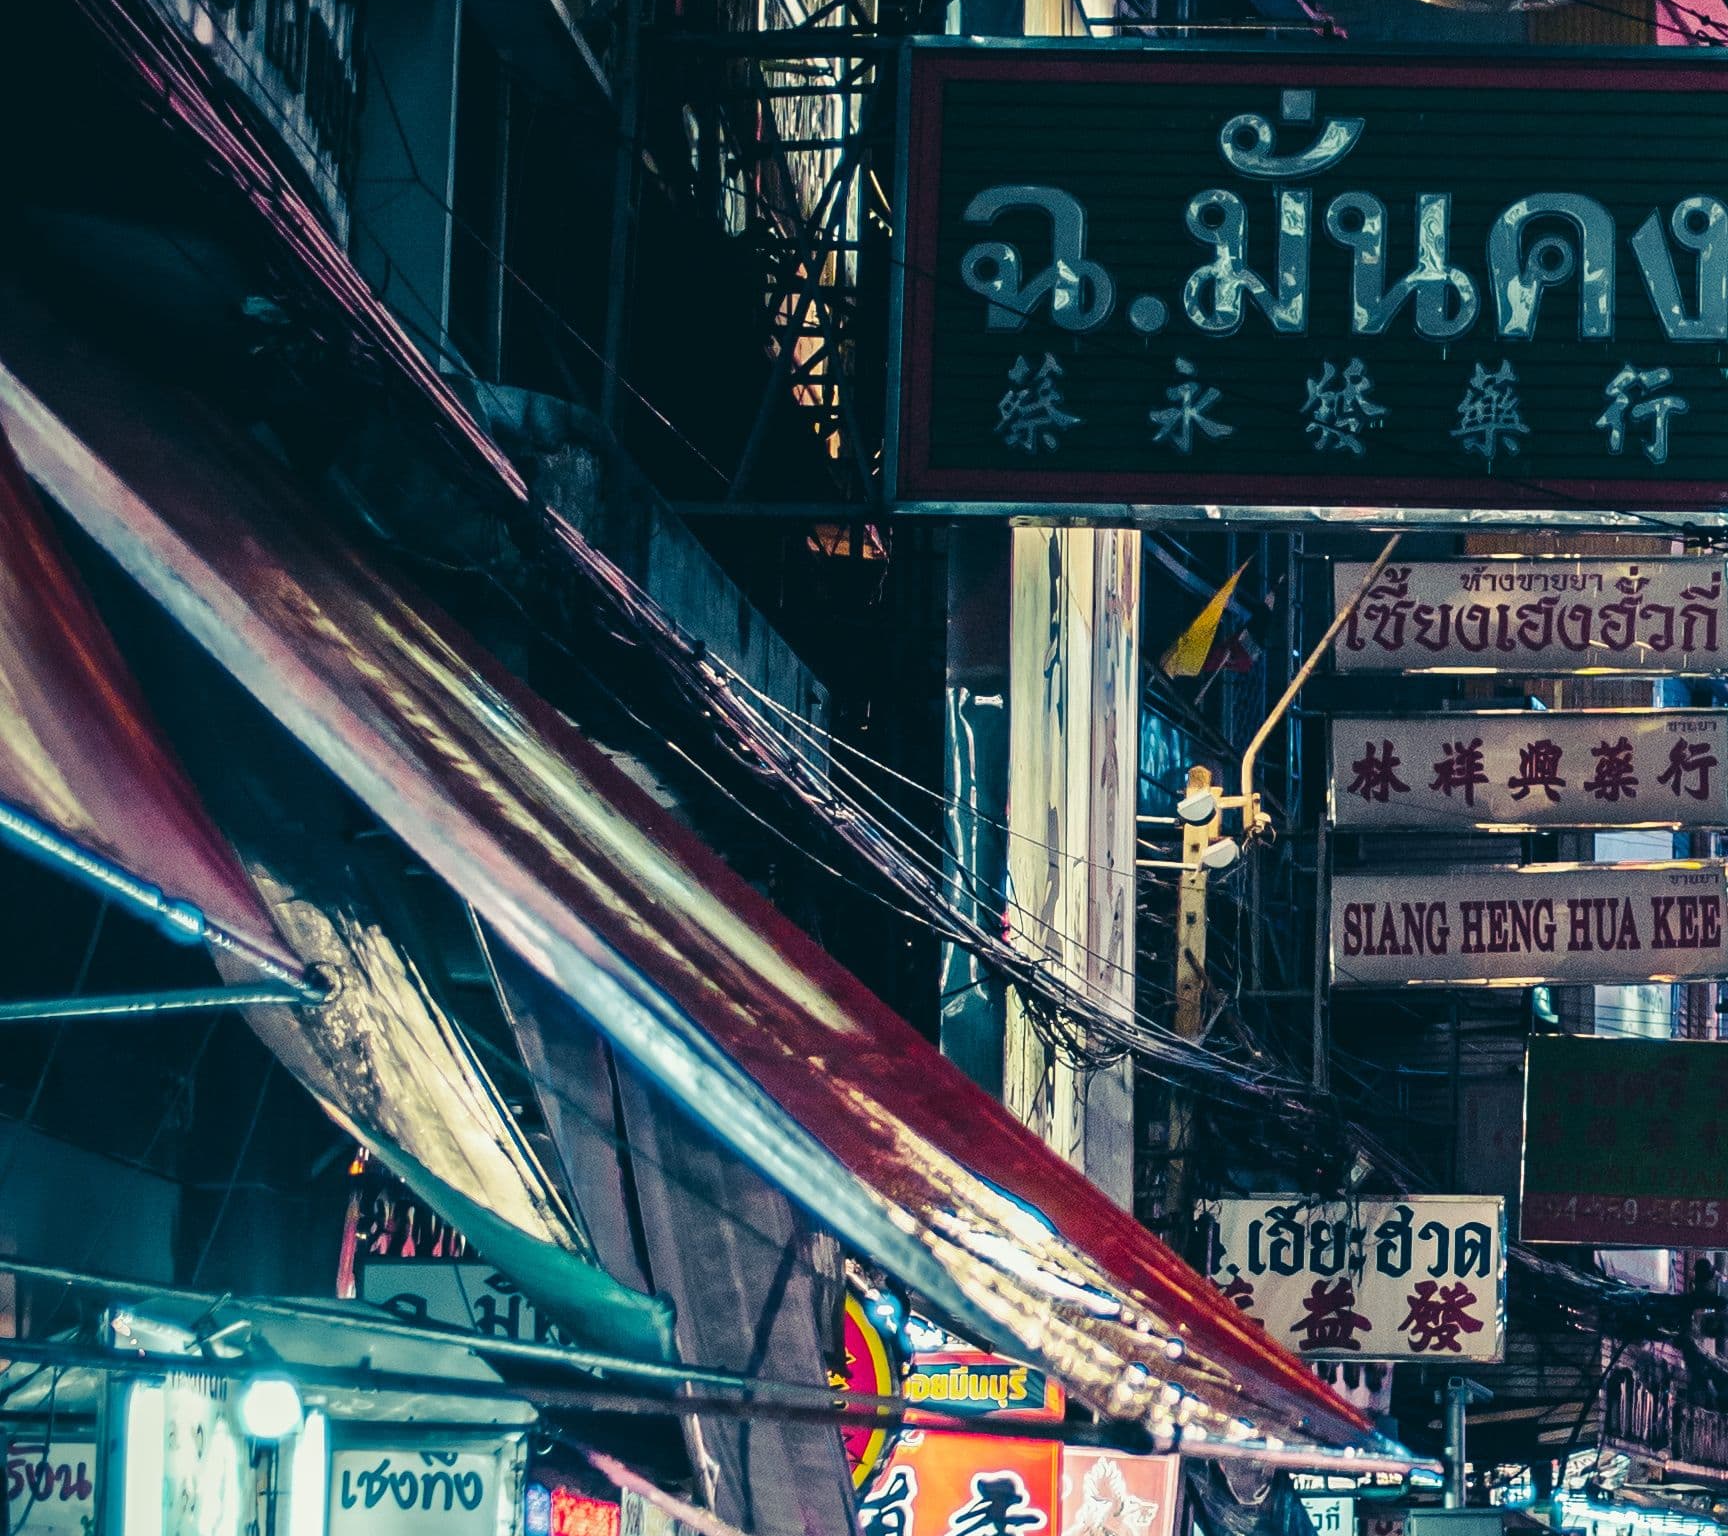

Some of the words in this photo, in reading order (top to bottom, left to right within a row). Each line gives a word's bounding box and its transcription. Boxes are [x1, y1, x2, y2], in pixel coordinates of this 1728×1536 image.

[1460, 566, 1604, 592] ห้างขายยา
[1342, 900, 1451, 957] SIANG
[1459, 897, 1558, 954] HENG
[1566, 895, 1642, 952] HUA
[1650, 894, 1722, 950] KEE
